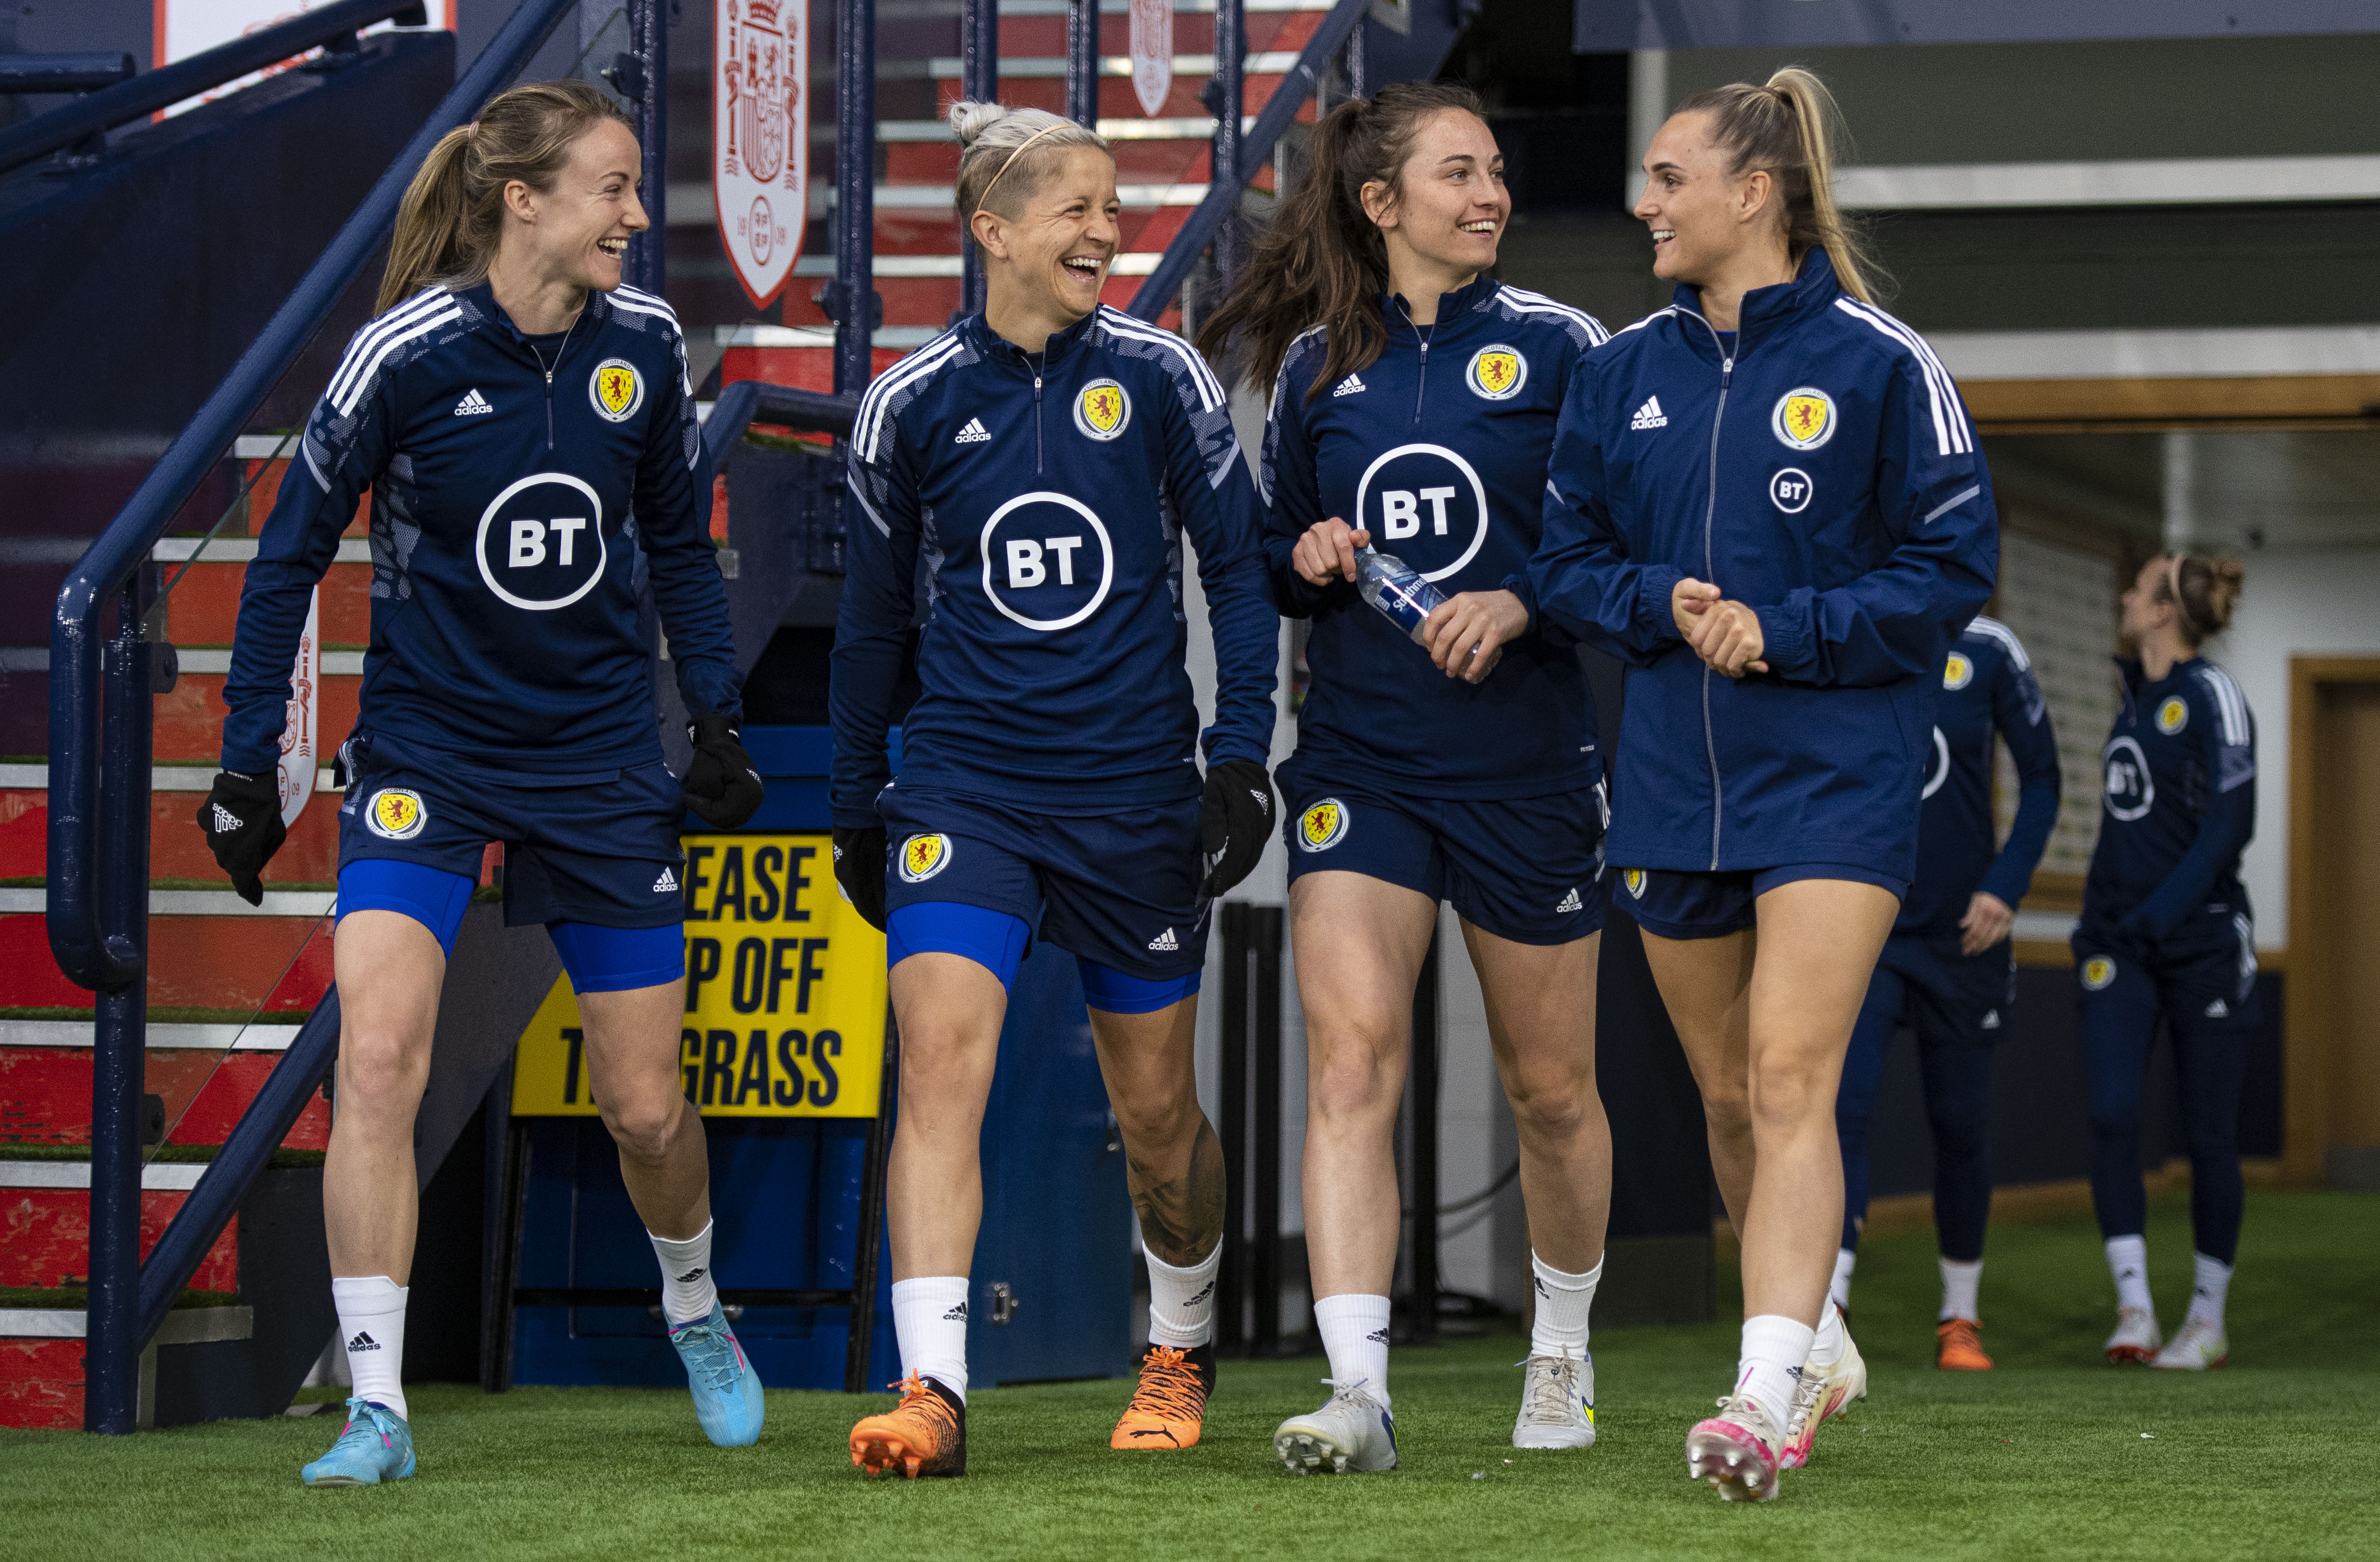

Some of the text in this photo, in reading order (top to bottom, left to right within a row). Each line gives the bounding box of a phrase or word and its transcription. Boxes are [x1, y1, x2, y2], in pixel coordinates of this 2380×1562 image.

[1483, 345, 1514, 354] SCOTLAND
[603, 359, 631, 369] SCOTLAND
[1086, 379, 1115, 389] SCOTLAND
[1333, 385, 1366, 397] adidas
[1793, 388, 1824, 398] SCOTLAND
[455, 403, 493, 416] adidas
[595, 406, 604, 415] EST
[625, 408, 635, 418] 1873
[1631, 416, 1667, 430] adidas
[1084, 428, 1093, 436] EST
[955, 431, 991, 444] adidas
[1780, 481, 1805, 500] BT
[1382, 486, 1455, 540] BT
[508, 518, 586, 568] BT
[1006, 536, 1082, 588] BT
[386, 788, 417, 798] SCOTLAND
[212, 803, 243, 827] adidas
[1330, 837, 1340, 846] 1873
[653, 883, 678, 892] adidas
[684, 845, 816, 922] EASE
[1556, 902, 1582, 912] adidas
[1148, 942, 1179, 950] adidas
[731, 937, 829, 1015] OFF
[679, 1029, 841, 1107] GRASS
[348, 1343, 381, 1352] adidas
